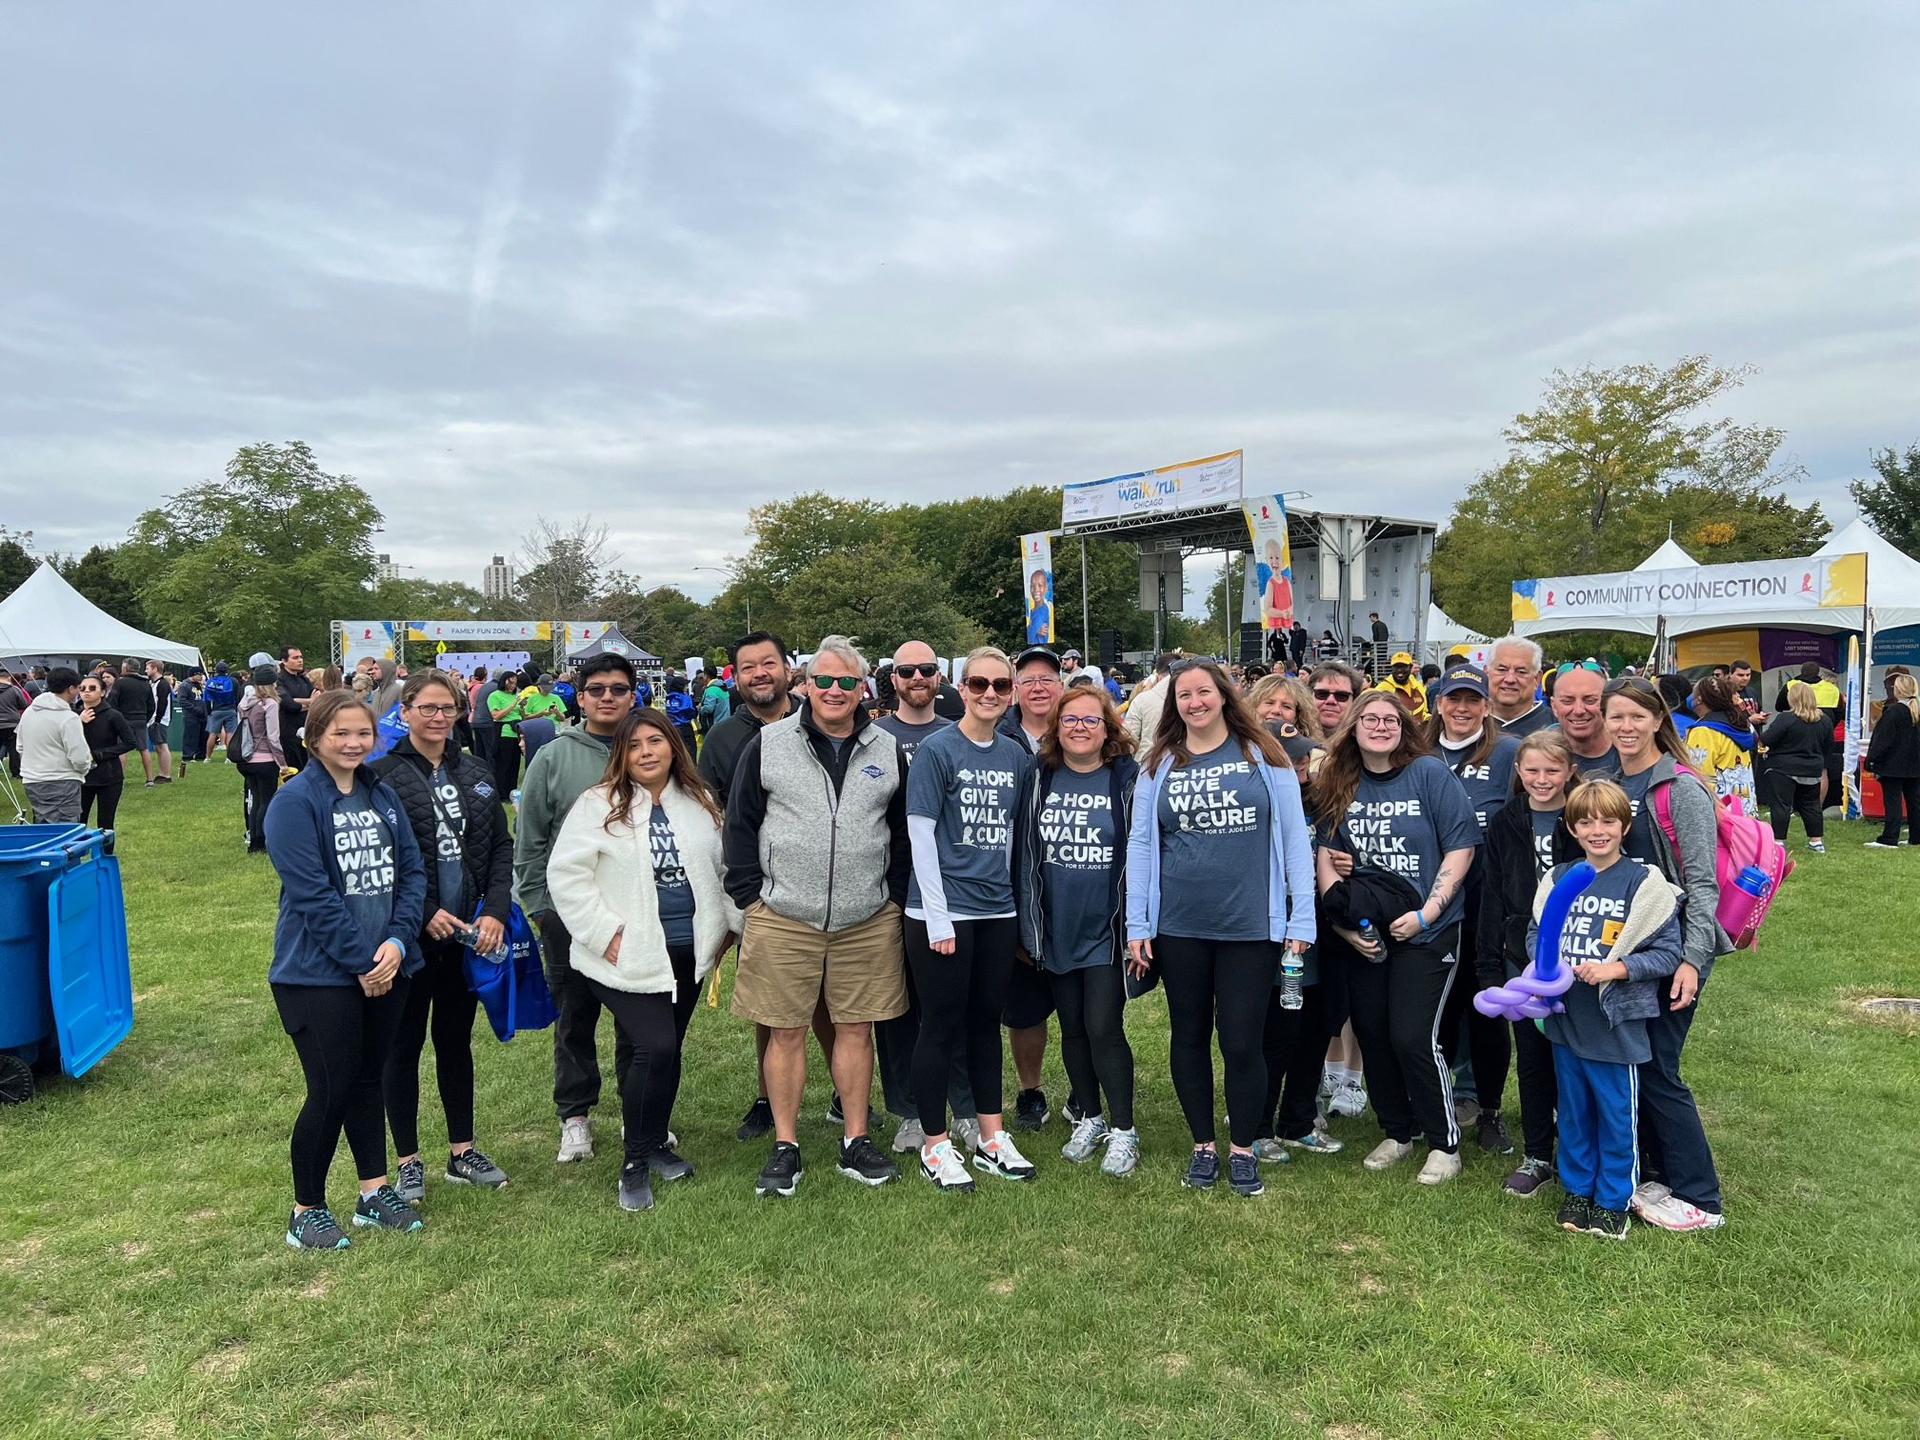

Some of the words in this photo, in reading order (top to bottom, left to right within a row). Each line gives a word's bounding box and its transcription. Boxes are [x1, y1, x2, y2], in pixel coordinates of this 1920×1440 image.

[1133, 497, 1163, 509] CHICAGO
[1565, 584, 1655, 606] COMMUNITY
[1658, 576, 1787, 601] CONNECTION
[975, 769, 1014, 788] HOPE
[1190, 761, 1250, 780] HOPE
[1463, 764, 1490, 781] PE
[1168, 778, 1220, 794] GIVE
[960, 787, 998, 806] GIVE
[1168, 790, 1240, 812] WALK
[960, 806, 1007, 825] WALK
[1040, 809, 1088, 825] GIVE
[1195, 806, 1256, 828] CURE
[1366, 800, 1421, 817] HOPE
[1038, 825, 1101, 844] WALK
[1347, 819, 1391, 835] GIVE
[335, 828, 380, 850] GIVE
[1349, 834, 1406, 853] WALK
[337, 846, 394, 871] WALK
[1059, 846, 1113, 862] CURE
[1371, 854, 1420, 871] CURE
[1571, 895, 1625, 918] HOPE
